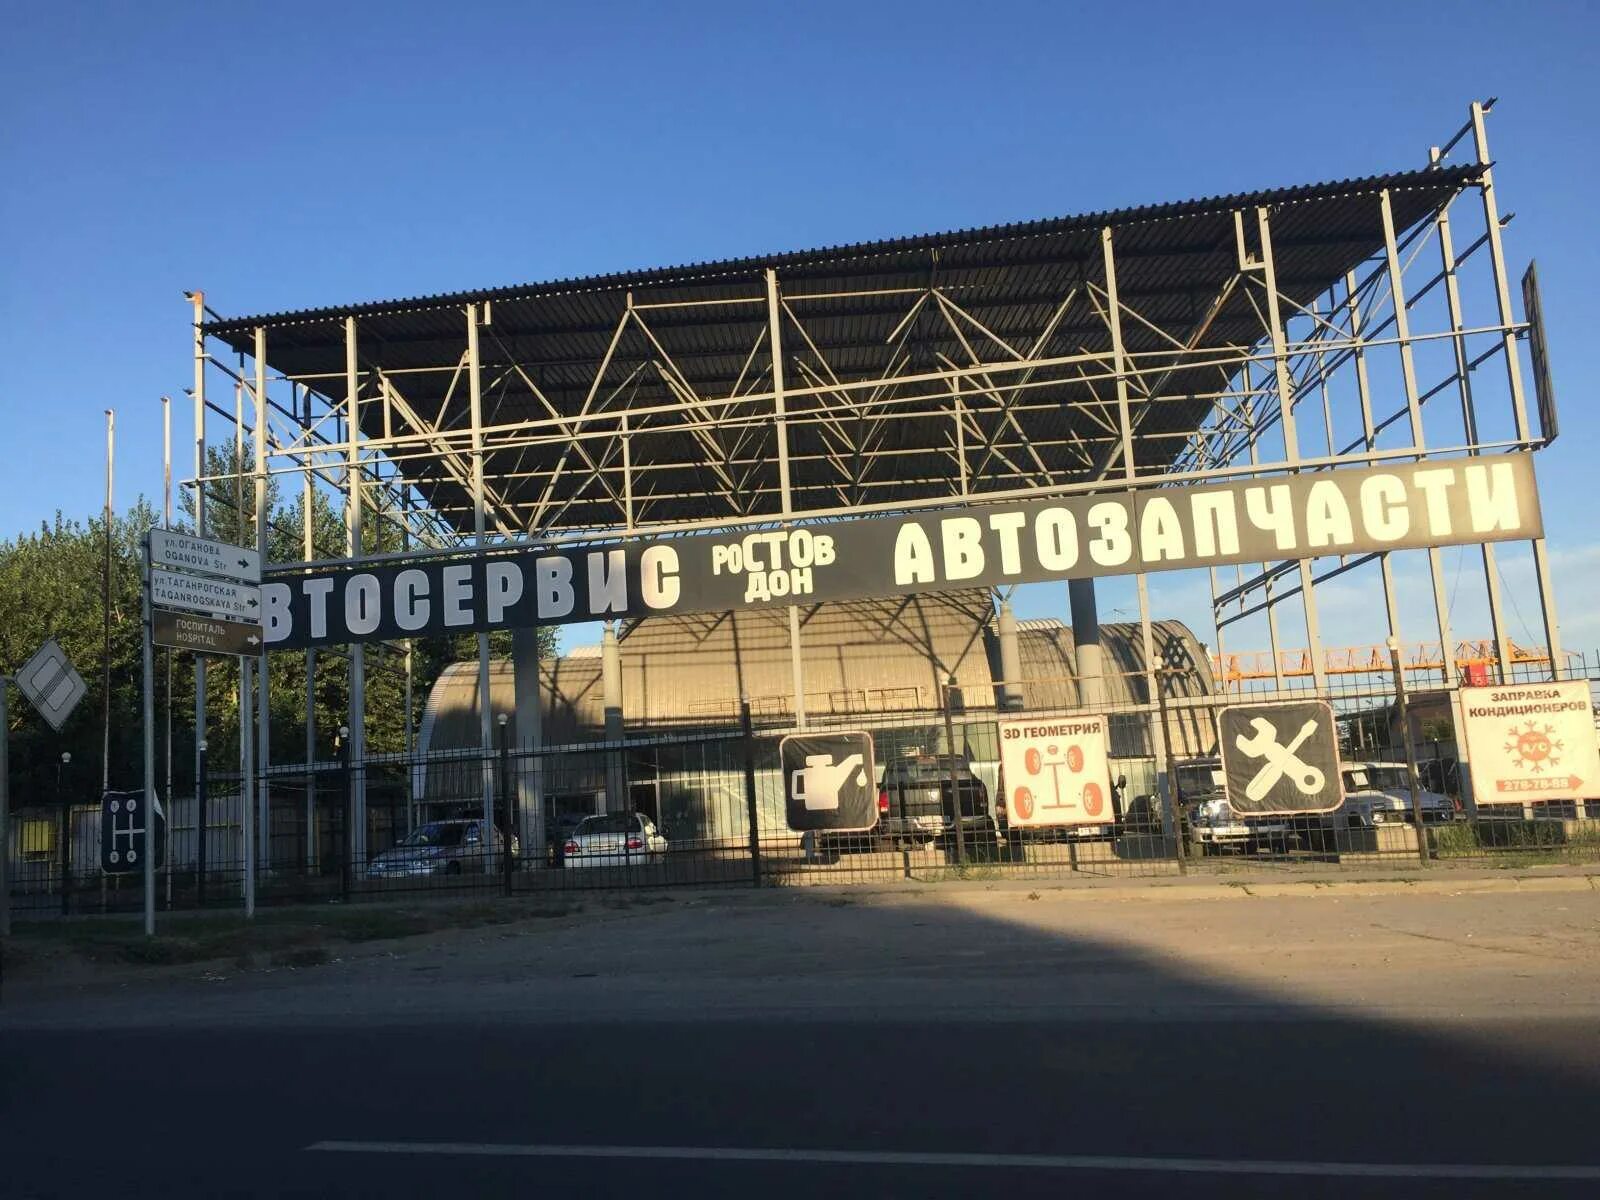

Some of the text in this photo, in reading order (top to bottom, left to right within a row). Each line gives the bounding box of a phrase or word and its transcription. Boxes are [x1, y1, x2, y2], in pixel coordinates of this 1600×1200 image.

[893, 461, 1521, 586] АВТОЗАПЧАСТИ
[165, 550, 209, 566] OGANOVA
[712, 529, 836, 575] РОСТОВ
[744, 567, 813, 603] ДОН
[154, 588, 231, 609] TAGANROGSKAYA
[258, 545, 681, 643] ВТОСЕРВИС
[176, 619, 226, 635] ГОСПИТАЛЬ
[176, 632, 217, 646] HOSPITAL
[1491, 690, 1561, 702] ЗАПРАВКА
[1469, 701, 1587, 718] КОНДИЦИОНЕРОВ
[1004, 722, 1101, 739] 3D ГЕОМЕТРИЯ
